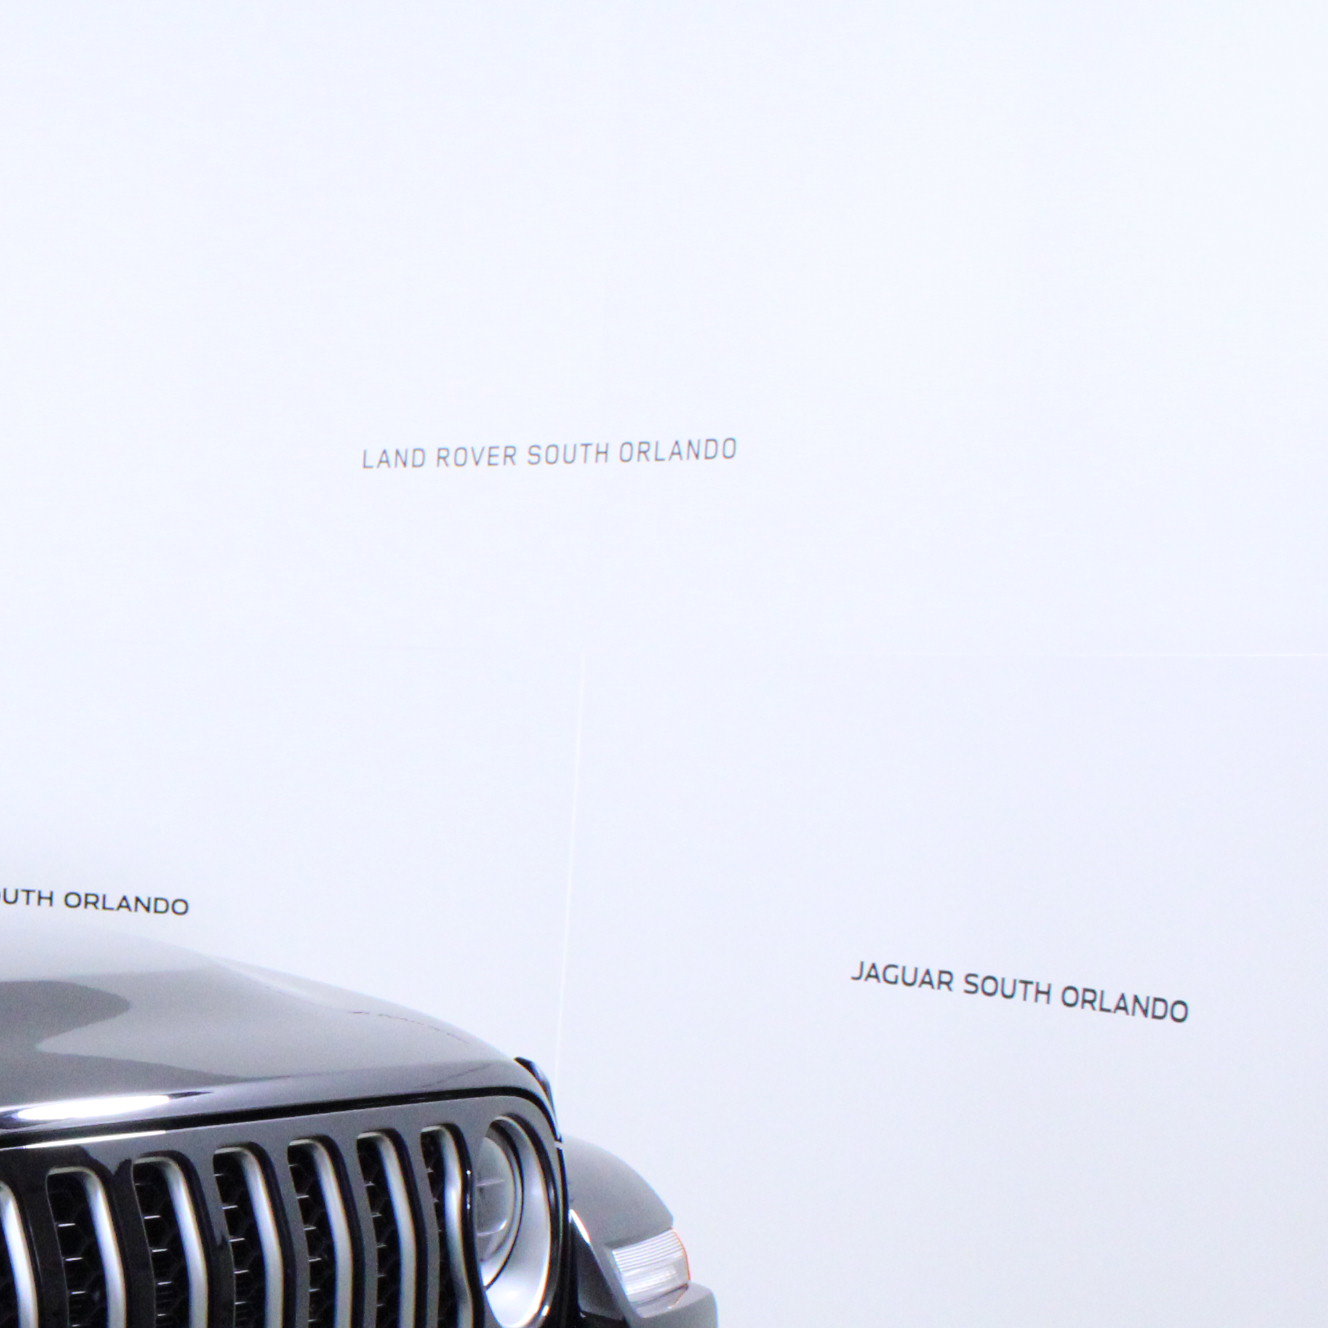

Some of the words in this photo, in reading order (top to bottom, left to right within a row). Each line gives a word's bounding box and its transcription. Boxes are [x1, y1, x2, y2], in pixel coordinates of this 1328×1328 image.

[361, 448, 426, 469] LAND
[436, 445, 518, 467] ROVER
[527, 442, 609, 466] SOUTH
[619, 437, 738, 463] ORLANDO
[64, 891, 189, 916] ORLANDO
[850, 960, 954, 992] JAGUAR
[963, 973, 1052, 1005] SOUTH
[1061, 986, 1189, 1024] ORLANDO
